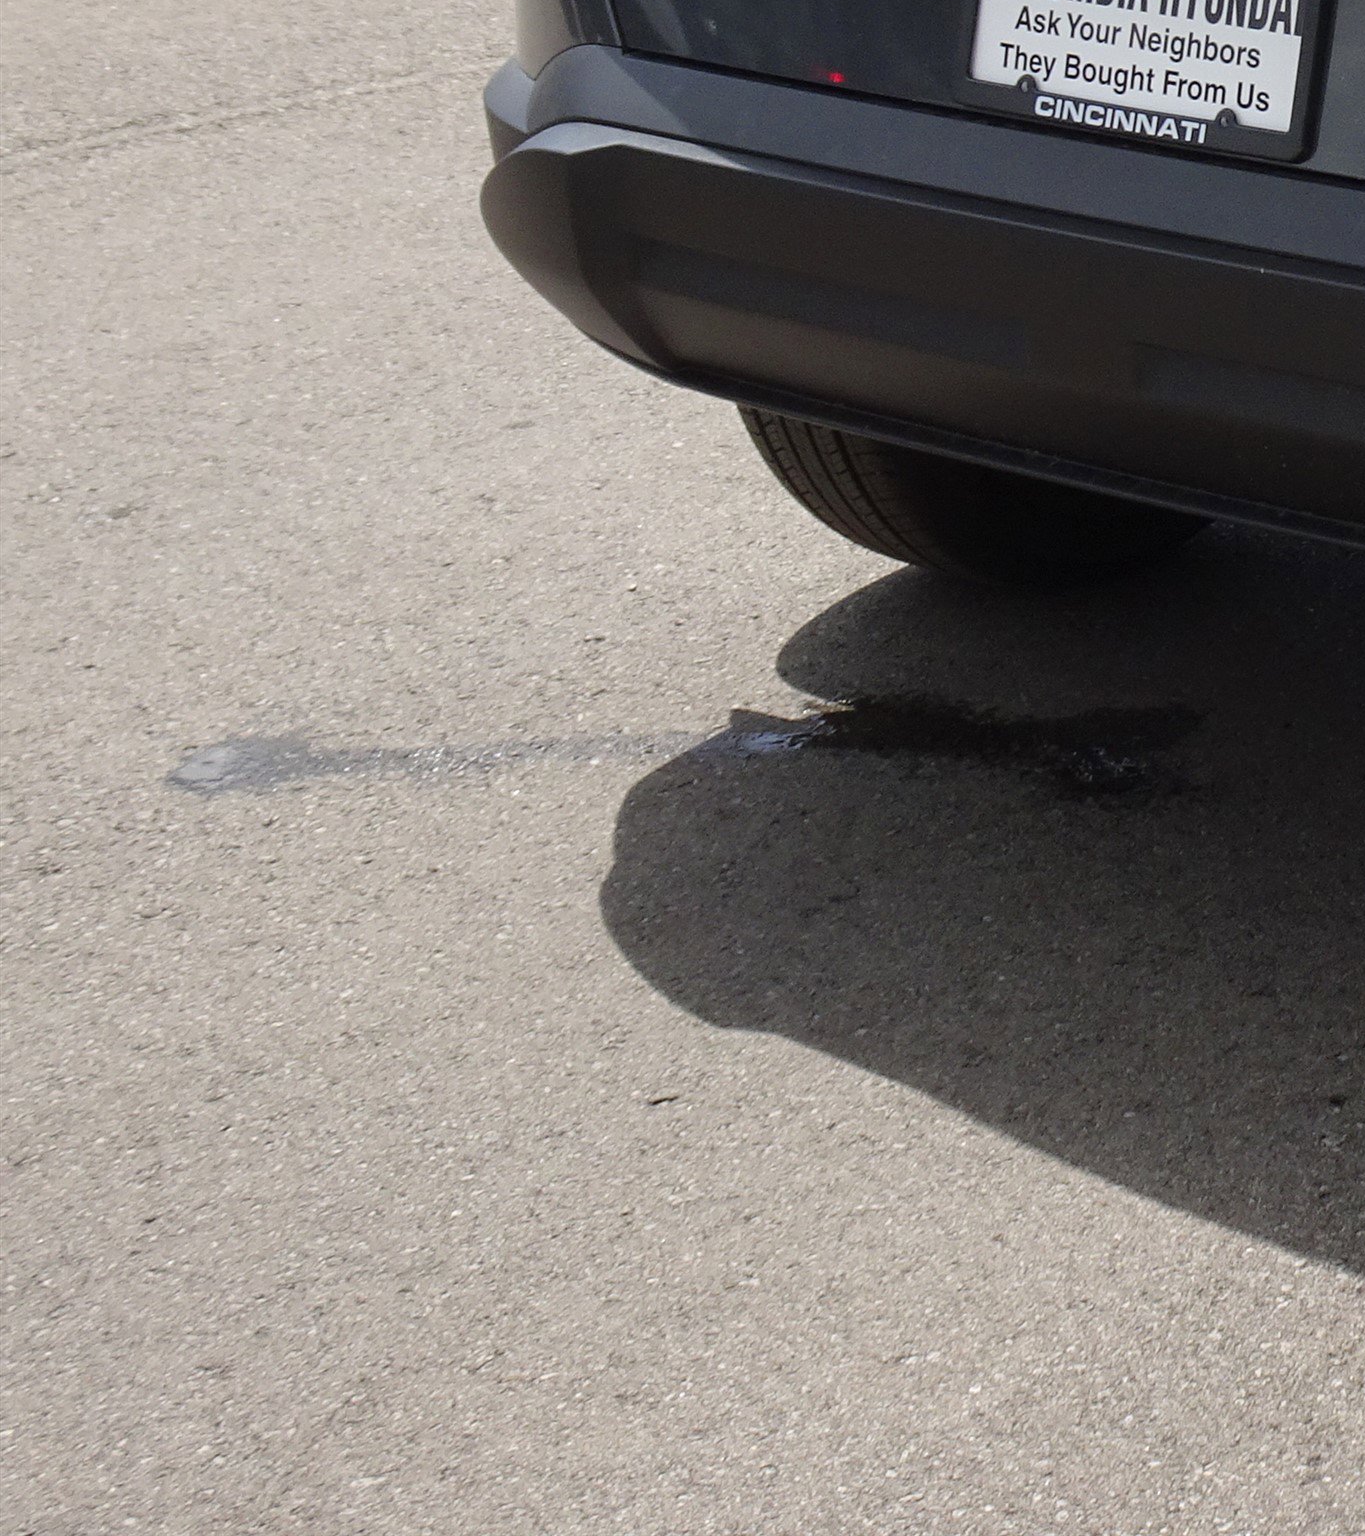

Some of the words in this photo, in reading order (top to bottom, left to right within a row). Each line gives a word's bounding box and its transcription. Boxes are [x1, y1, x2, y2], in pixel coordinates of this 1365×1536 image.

[1015, 5, 1060, 37] Ask
[1067, 13, 1122, 46] Your
[1129, 23, 1261, 69] Neighbors
[1000, 42, 1056, 81] They
[1064, 54, 1155, 95] Bought
[1163, 71, 1226, 105] From
[1236, 82, 1270, 112] Us
[1034, 95, 1208, 145] CINCINNATI
